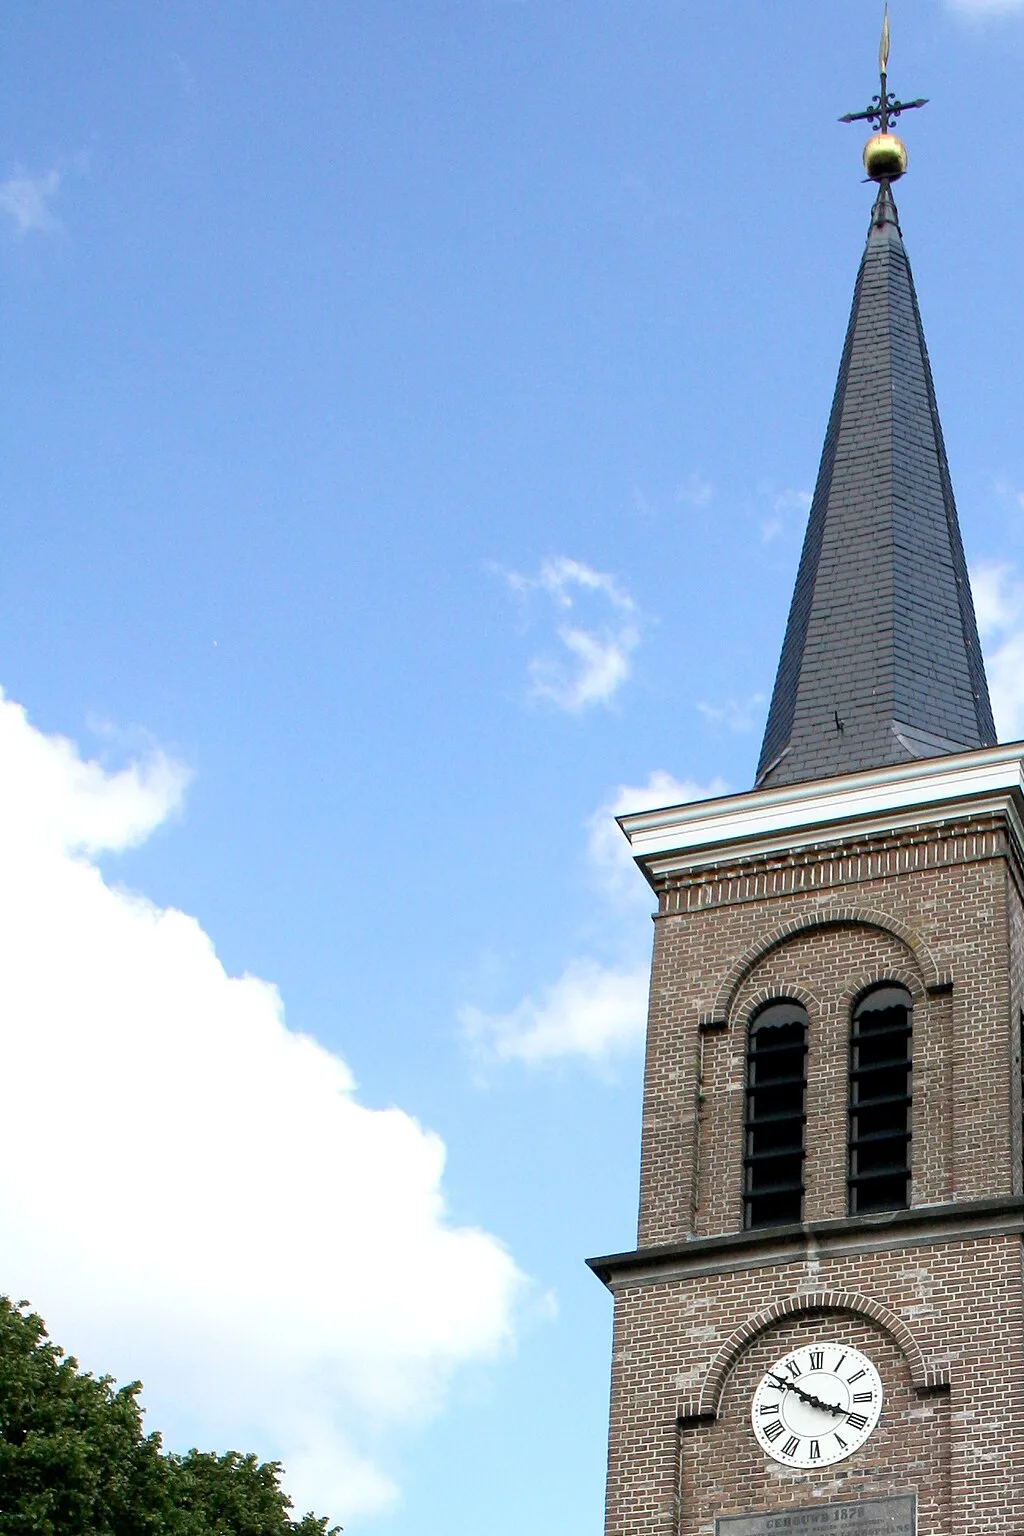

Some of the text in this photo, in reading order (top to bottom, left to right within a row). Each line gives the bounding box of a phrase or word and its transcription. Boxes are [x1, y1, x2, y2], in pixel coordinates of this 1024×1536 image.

[785, 1360, 801, 1378] XI
[809, 1352, 823, 1370] XII
[834, 1355, 846, 1372] I
[847, 1369, 866, 1384] II
[853, 1391, 872, 1403] III
[760, 1404, 779, 1415] IX
[763, 1419, 785, 1443] VIII
[781, 1436, 800, 1457] VII
[810, 1440, 820, 1459] VI
[834, 1433, 847, 1449] V
